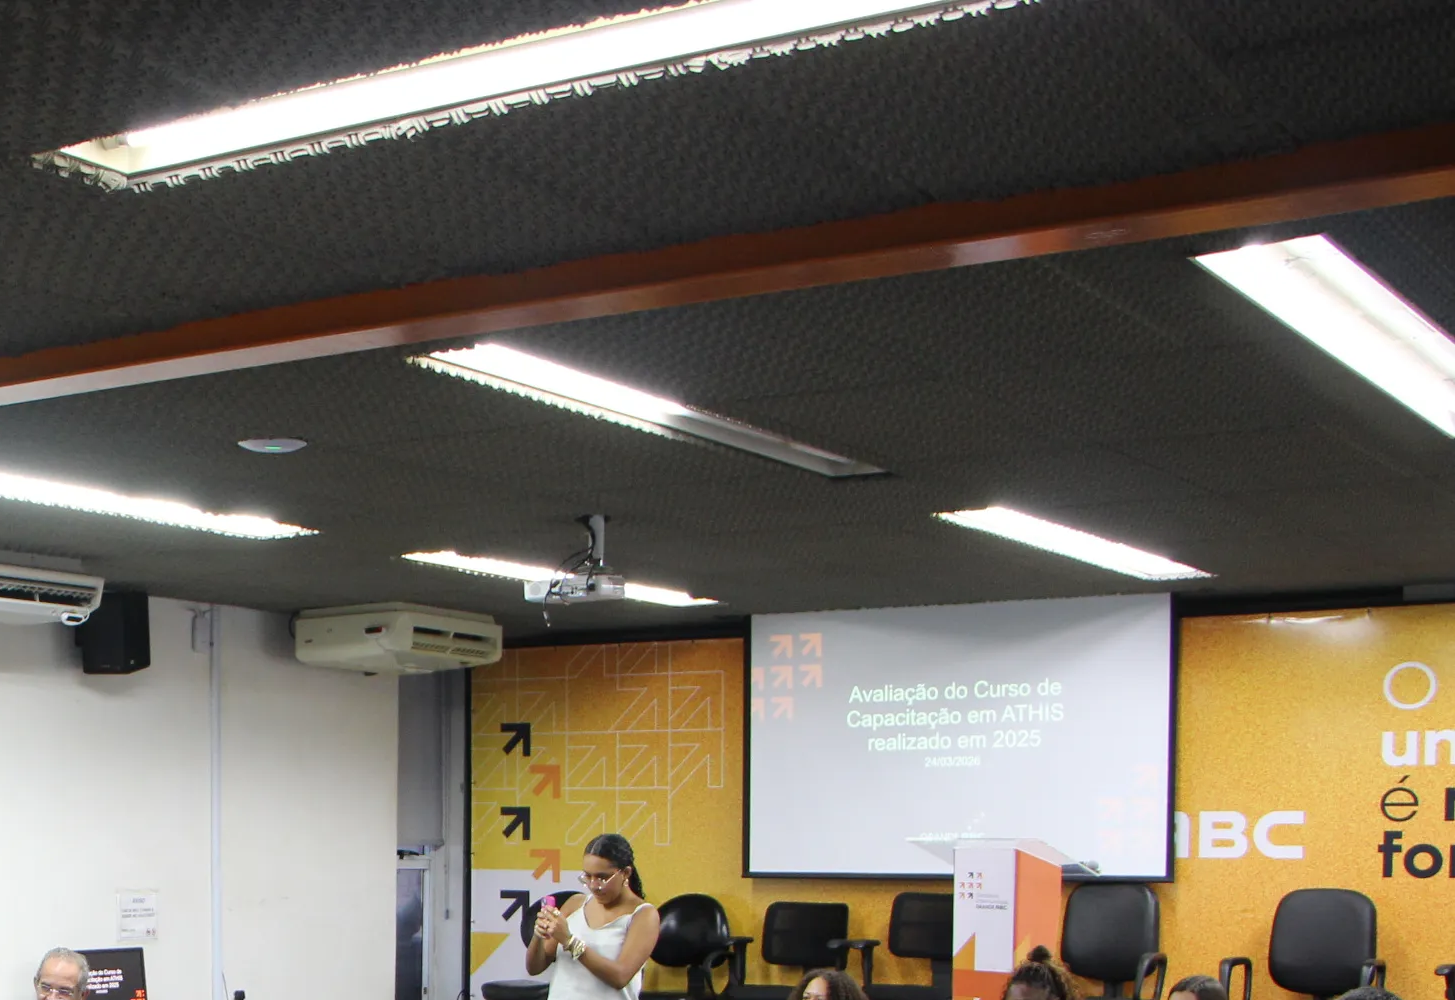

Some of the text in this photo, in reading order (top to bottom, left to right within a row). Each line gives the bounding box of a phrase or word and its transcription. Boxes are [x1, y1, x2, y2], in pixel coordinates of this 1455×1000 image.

[848, 678, 1062, 705] Avaliação do Curso de
[1383, 661, 1438, 710] O
[846, 703, 1064, 731] Capacitação em ATHIS
[867, 730, 1043, 752] realizado em 2025
[1381, 775, 1419, 822] é
